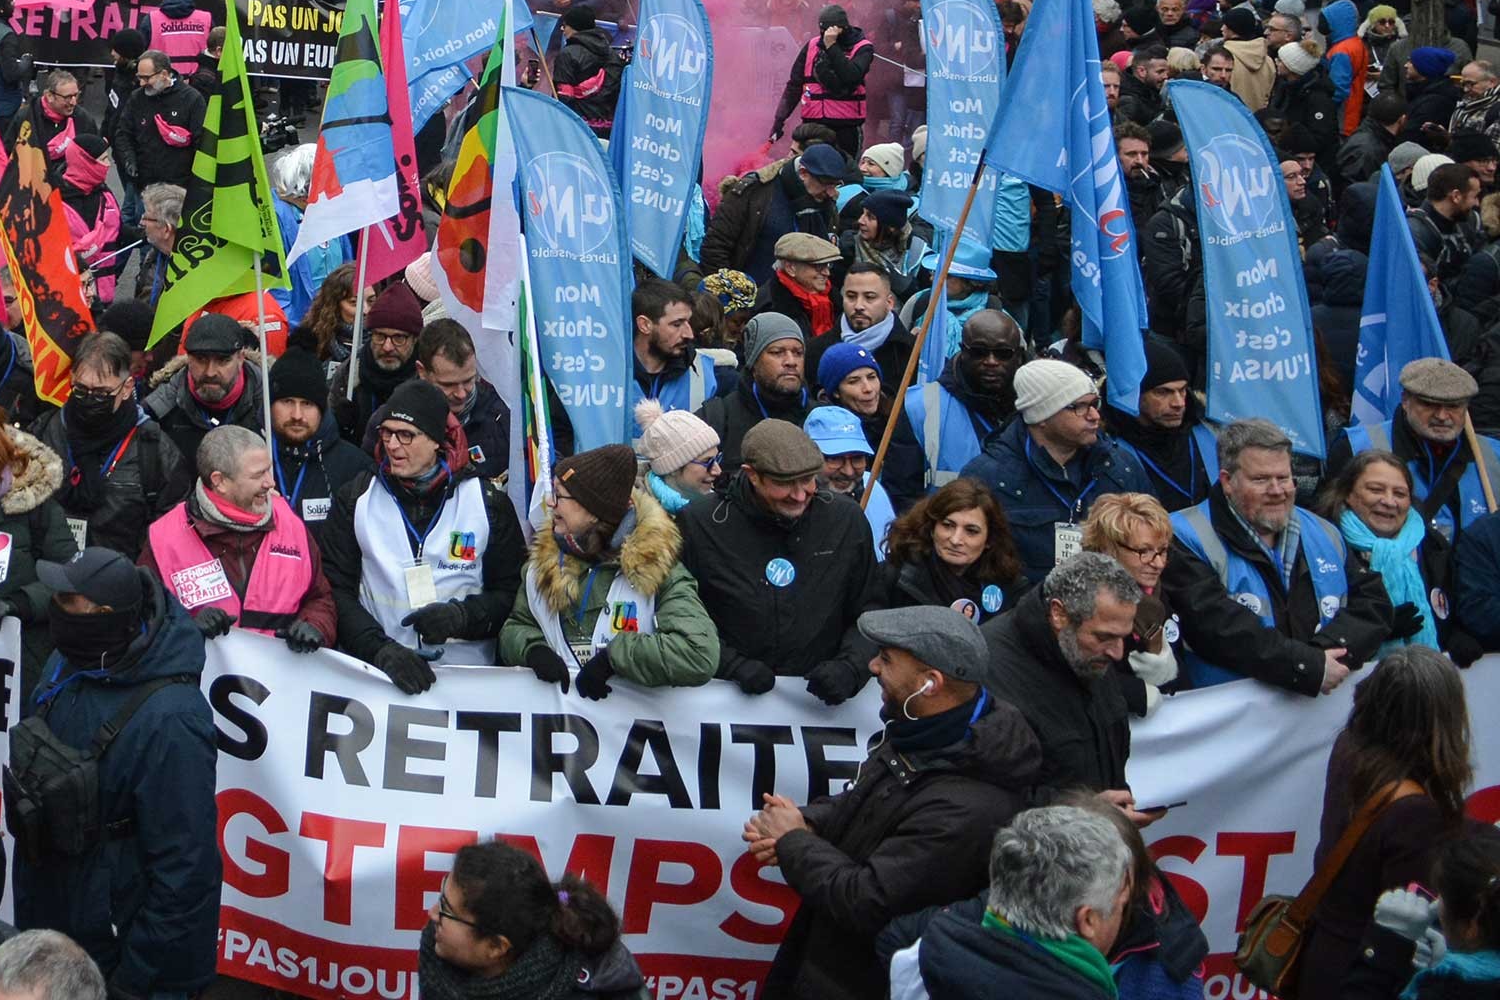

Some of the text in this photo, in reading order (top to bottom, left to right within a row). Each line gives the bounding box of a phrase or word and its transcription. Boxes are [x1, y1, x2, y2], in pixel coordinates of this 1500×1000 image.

[160, 21, 205, 34] Solidaires
[247, 0, 287, 28] PAS
[291, 5, 318, 31] UN
[271, 40, 298, 65] UN
[304, 690, 859, 811] RETRAITE
